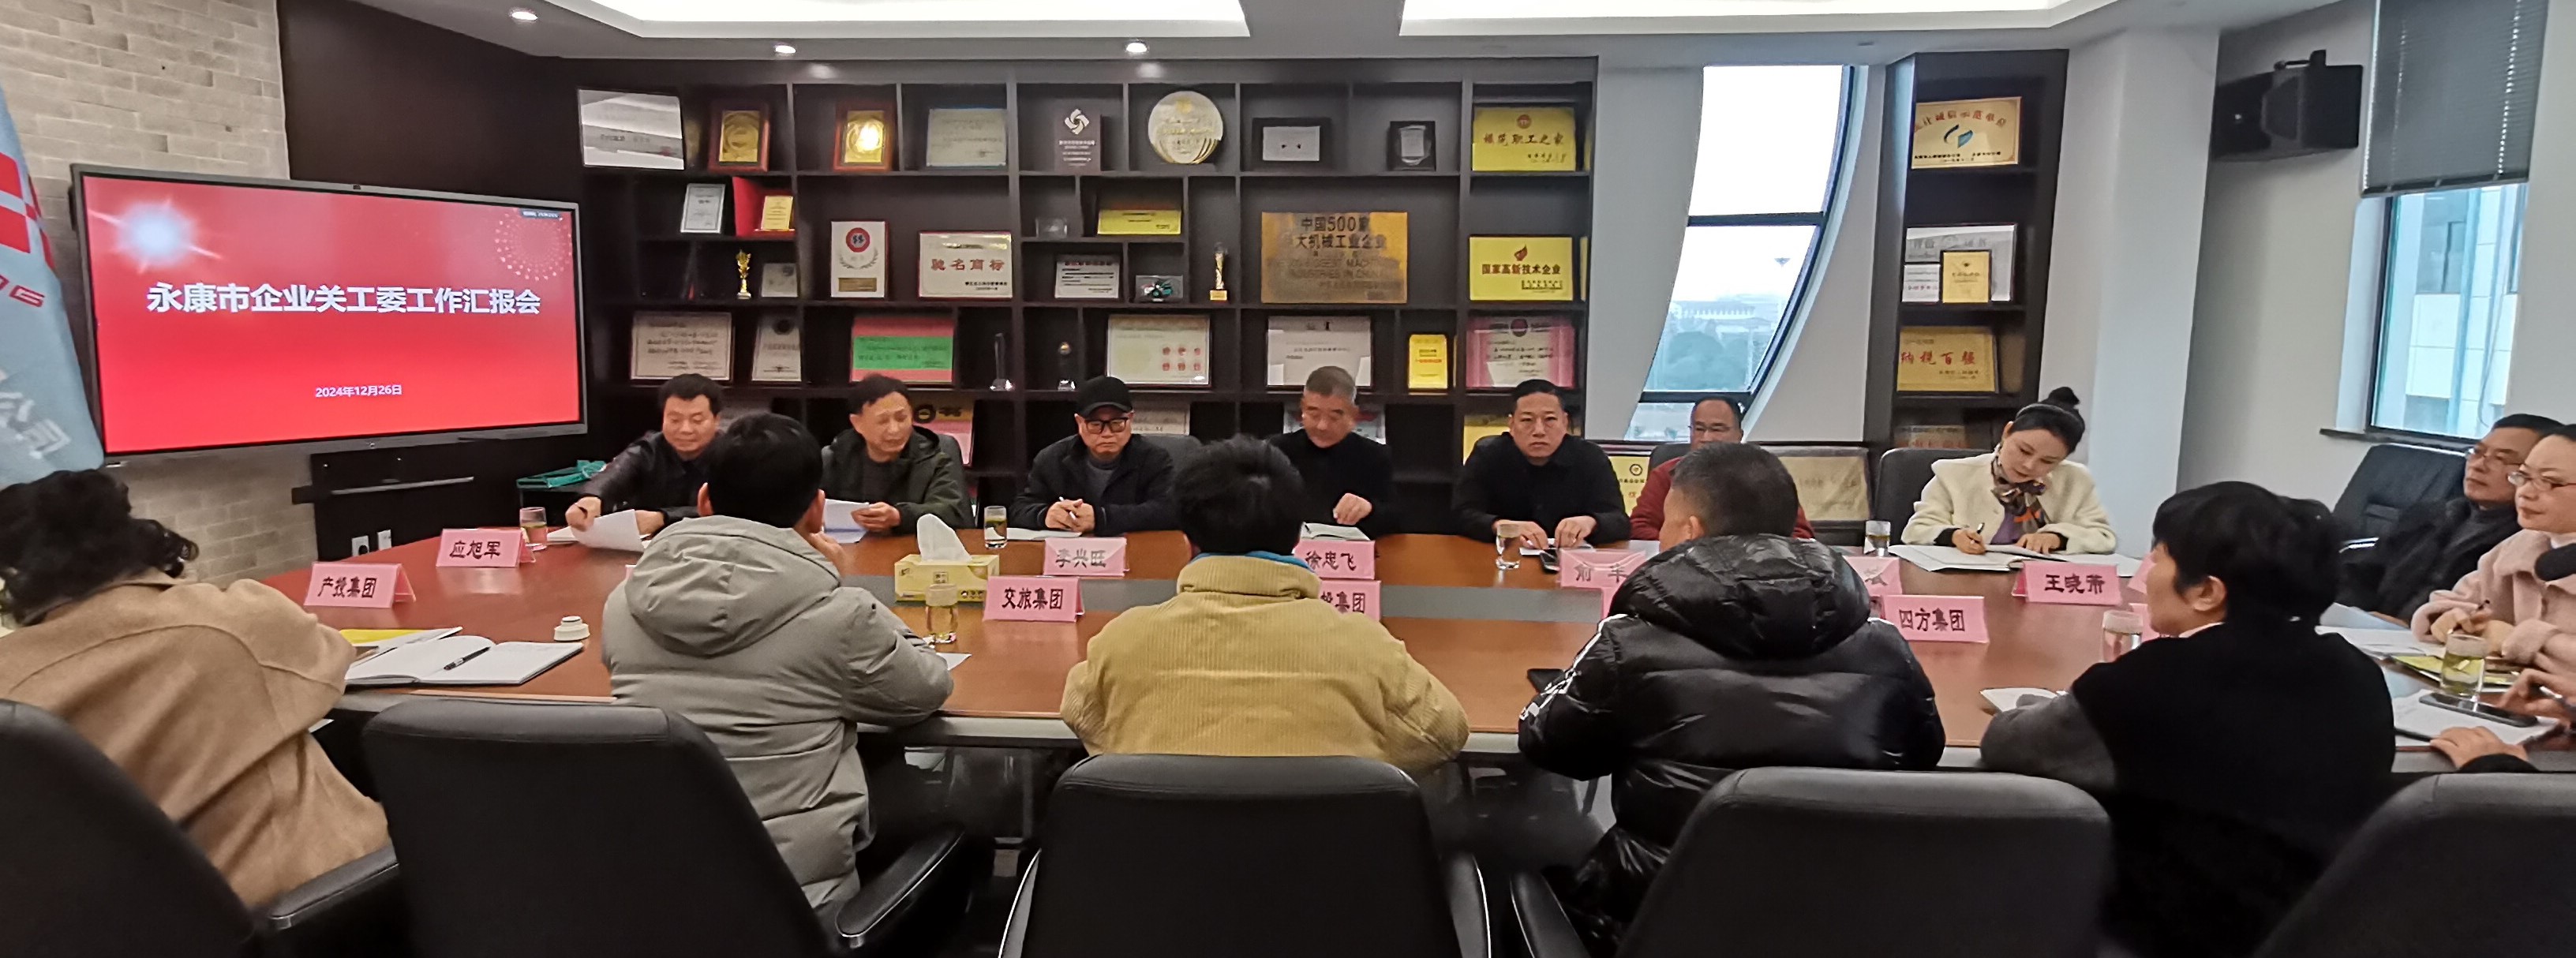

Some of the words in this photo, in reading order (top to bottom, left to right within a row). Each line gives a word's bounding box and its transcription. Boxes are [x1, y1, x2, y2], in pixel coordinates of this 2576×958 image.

[1282, 233, 1386, 249] 大机械工业企业
[1482, 264, 1561, 275] 国家高新技术企业
[146, 281, 541, 315] 永康市企业关工委工作汇报会
[315, 384, 402, 398] 2024年12月26日
[449, 540, 501, 560] 应旭军
[1055, 548, 1106, 569] 李兴旺
[1305, 550, 1357, 571] 徐忠飞
[317, 576, 377, 599] 产投集团
[1002, 587, 1064, 610] 交旅集团
[1898, 607, 1966, 632] 四方集团
